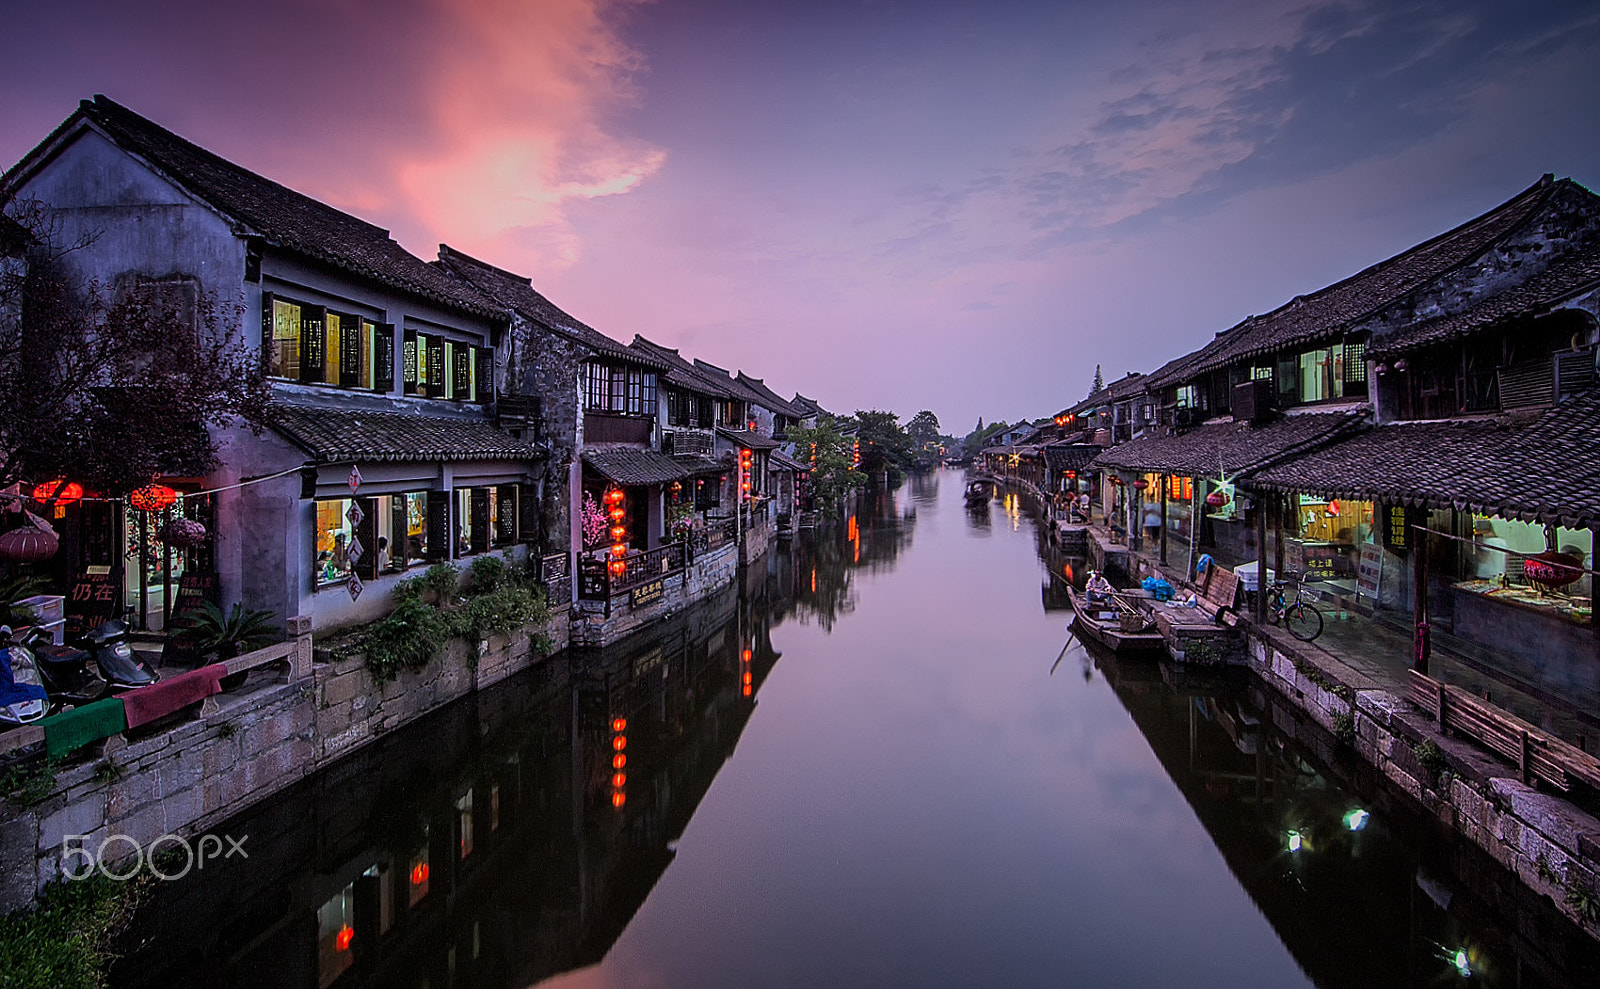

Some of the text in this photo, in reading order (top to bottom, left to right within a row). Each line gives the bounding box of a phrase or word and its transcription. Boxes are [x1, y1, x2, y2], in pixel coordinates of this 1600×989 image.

[348, 470, 362, 595] 江南人家
[72, 583, 115, 601] 仍在
